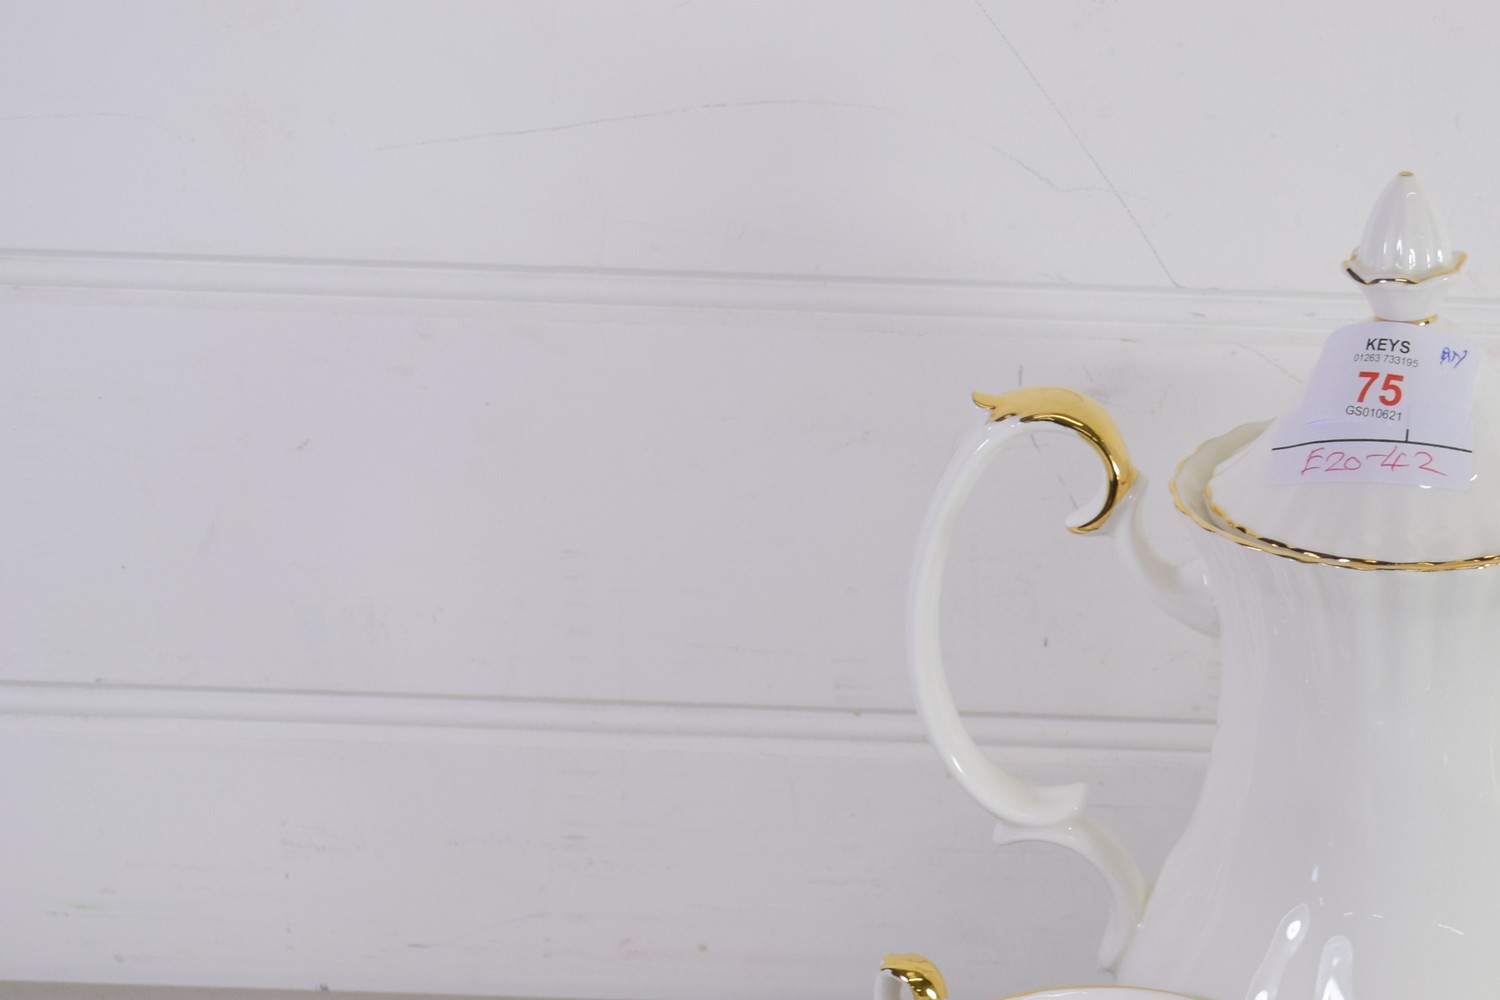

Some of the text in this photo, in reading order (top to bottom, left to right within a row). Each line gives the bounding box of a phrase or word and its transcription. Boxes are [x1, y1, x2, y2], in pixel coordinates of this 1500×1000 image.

[1365, 338, 1411, 354] KEYS
[1353, 353, 1419, 368] 01263 733195
[1357, 371, 1404, 406] 75
[1345, 405, 1402, 421] GS010621
